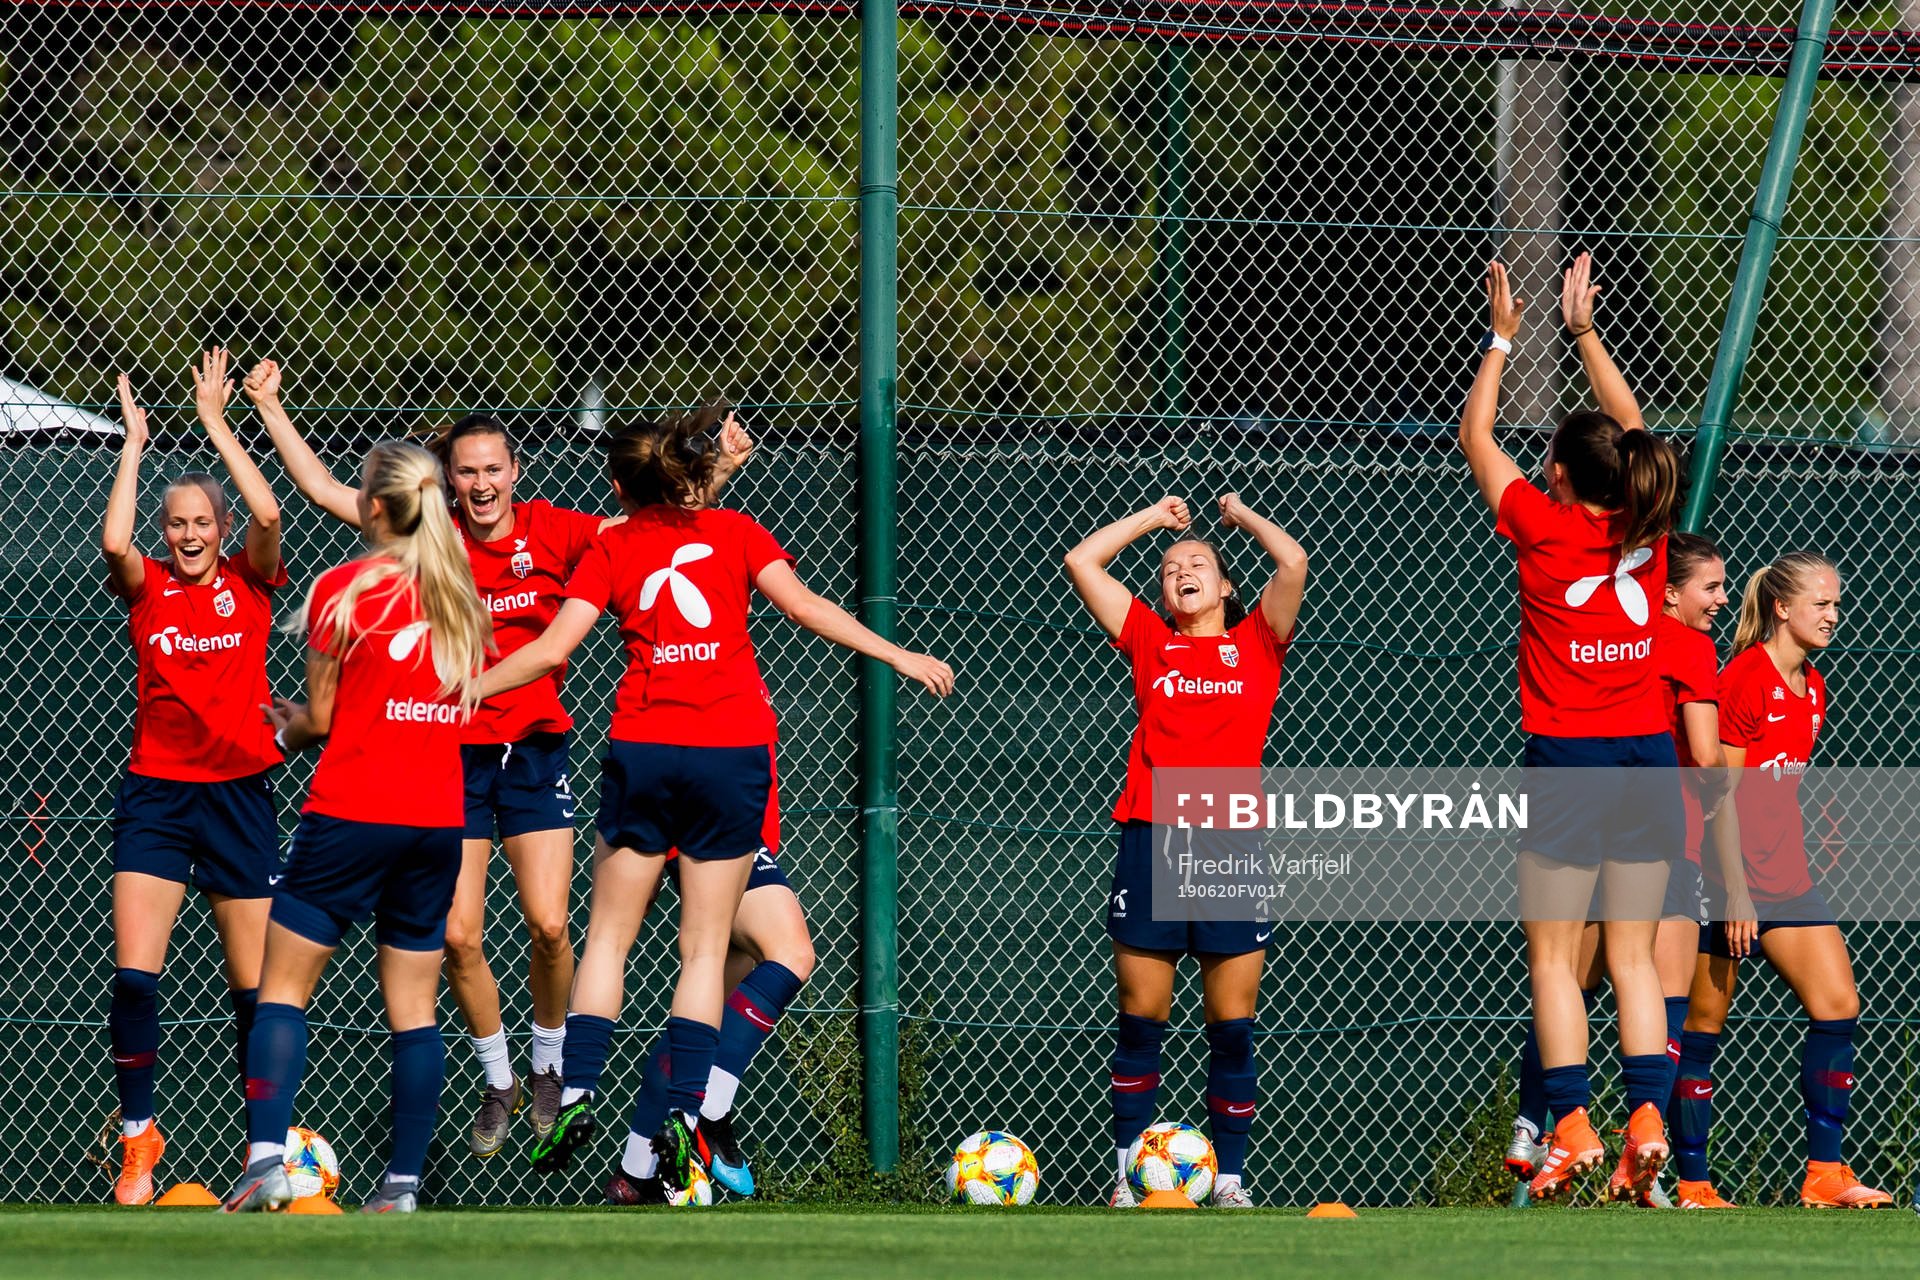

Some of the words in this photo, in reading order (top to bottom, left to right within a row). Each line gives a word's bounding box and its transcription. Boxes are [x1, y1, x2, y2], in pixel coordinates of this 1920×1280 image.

[481, 591, 538, 612] lenor
[175, 632, 242, 652] telenor
[1569, 637, 1652, 663] telenor
[1177, 676, 1244, 694] telenor
